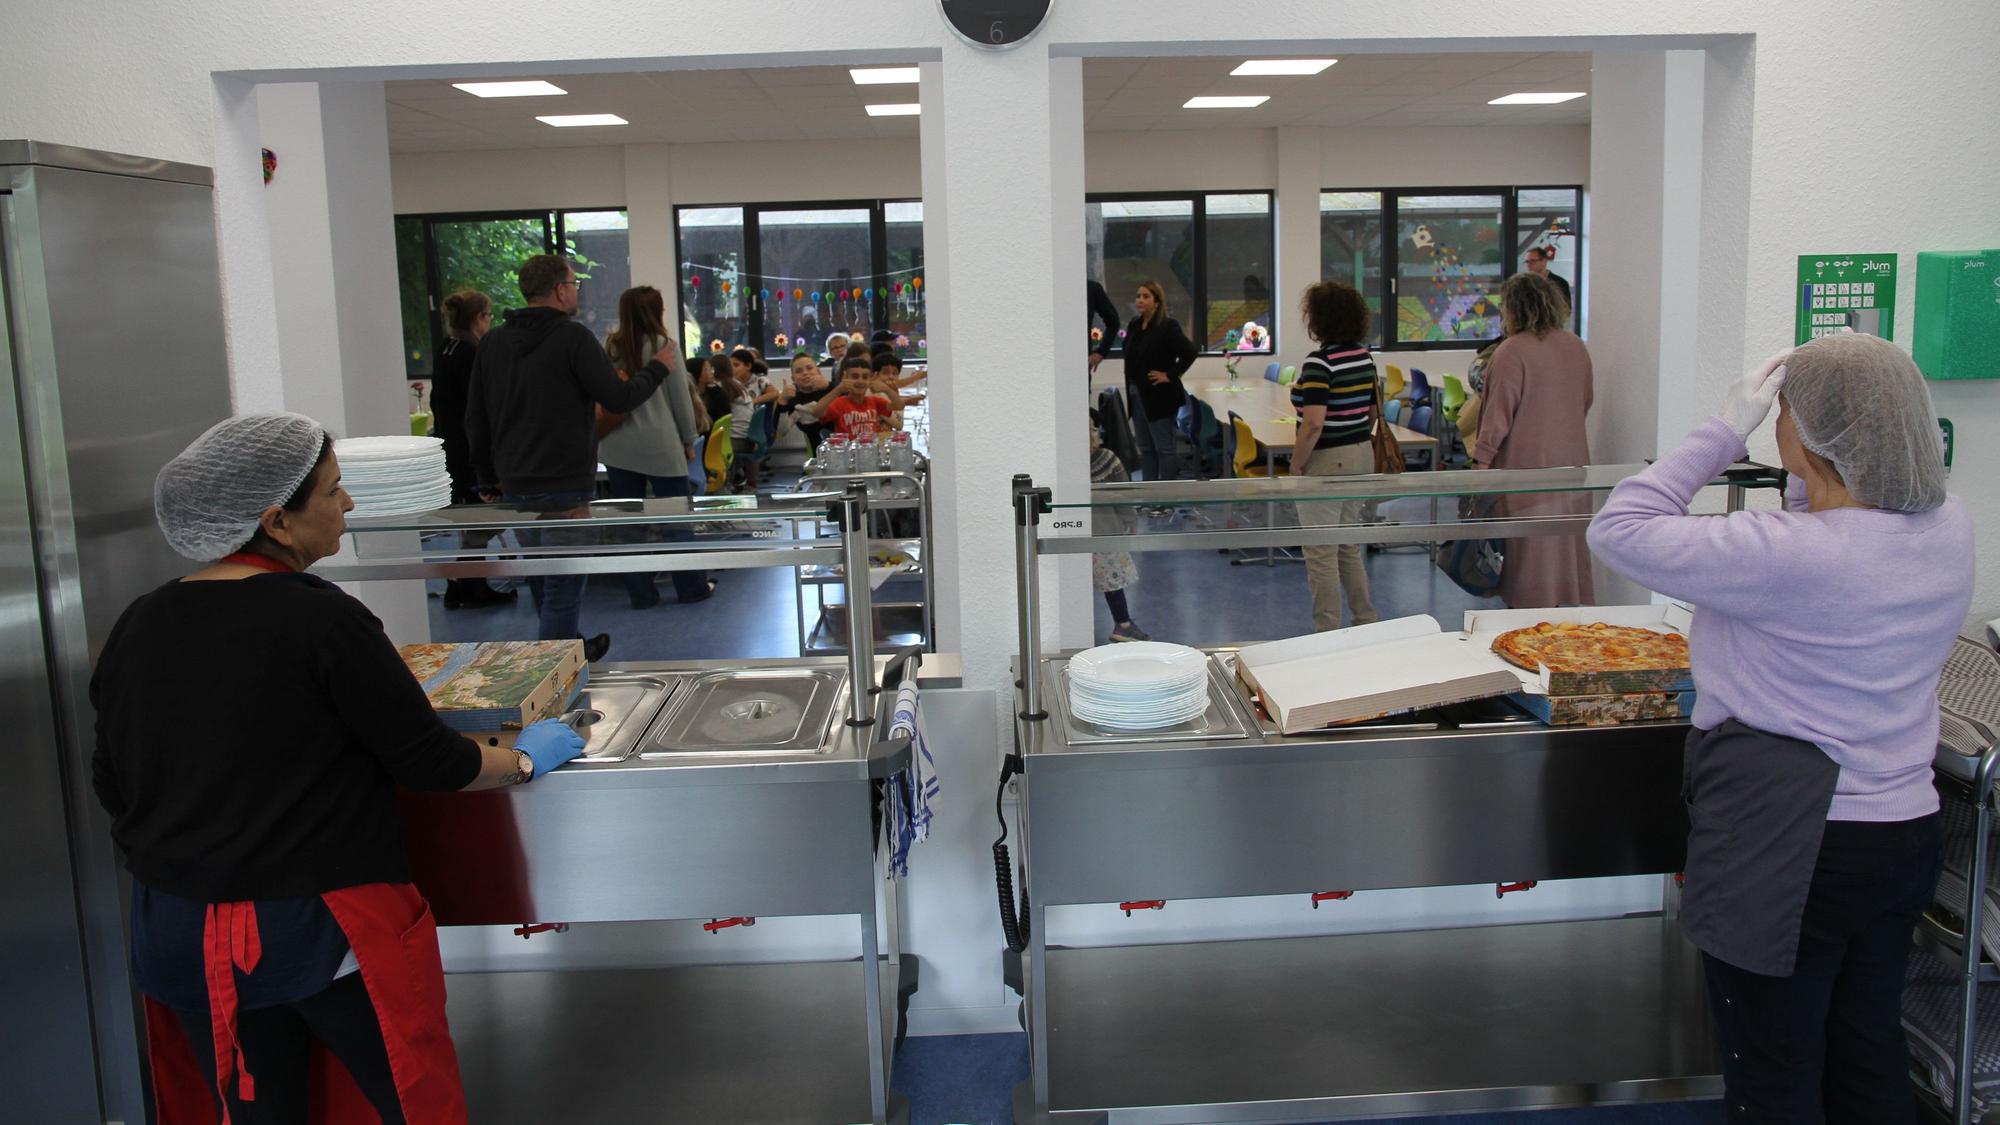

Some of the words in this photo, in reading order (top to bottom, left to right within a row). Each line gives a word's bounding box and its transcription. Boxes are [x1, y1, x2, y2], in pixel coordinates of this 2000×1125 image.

[990, 20, 1004, 43] 6
[1862, 260, 1890, 273] plum
[1964, 259, 1985, 269] plum
